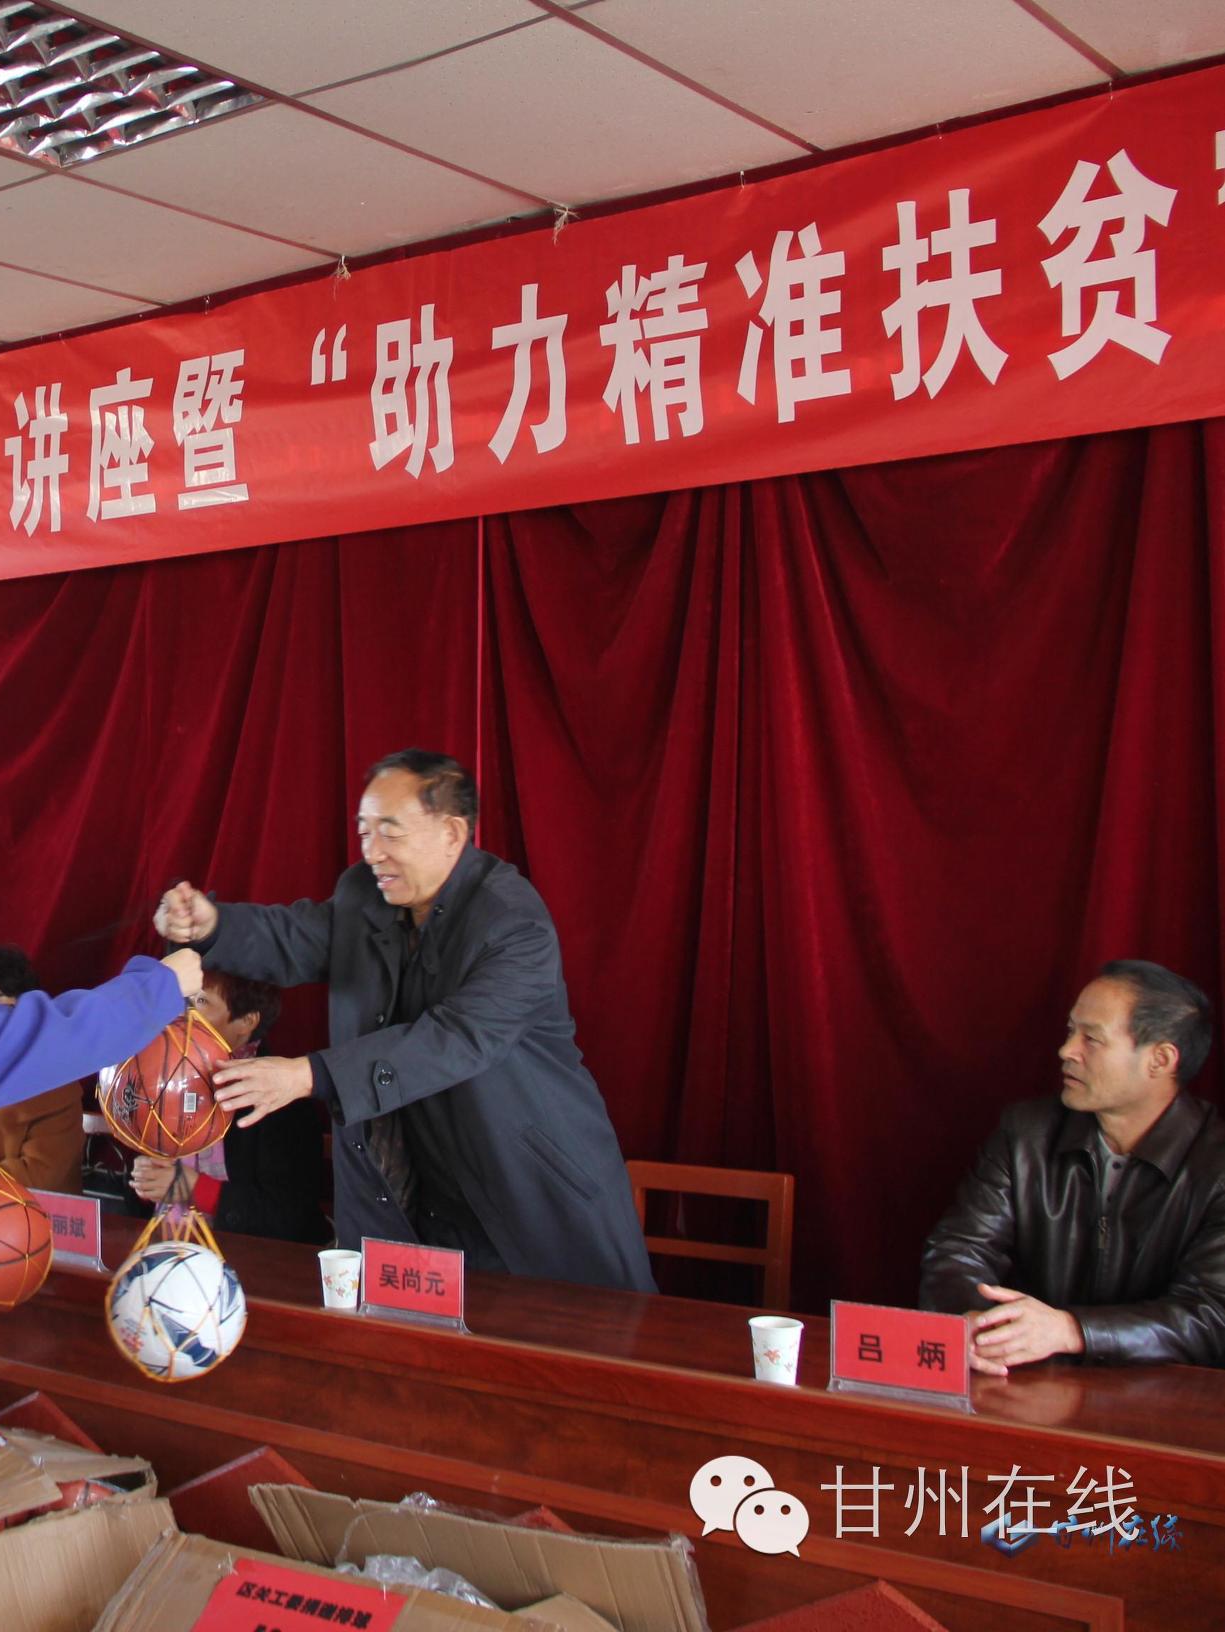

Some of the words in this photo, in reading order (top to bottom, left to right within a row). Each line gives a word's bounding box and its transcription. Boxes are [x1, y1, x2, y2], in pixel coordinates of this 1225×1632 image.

[48, 1213, 86, 1239] 丽斌
[379, 1263, 445, 1296] 吴尚元
